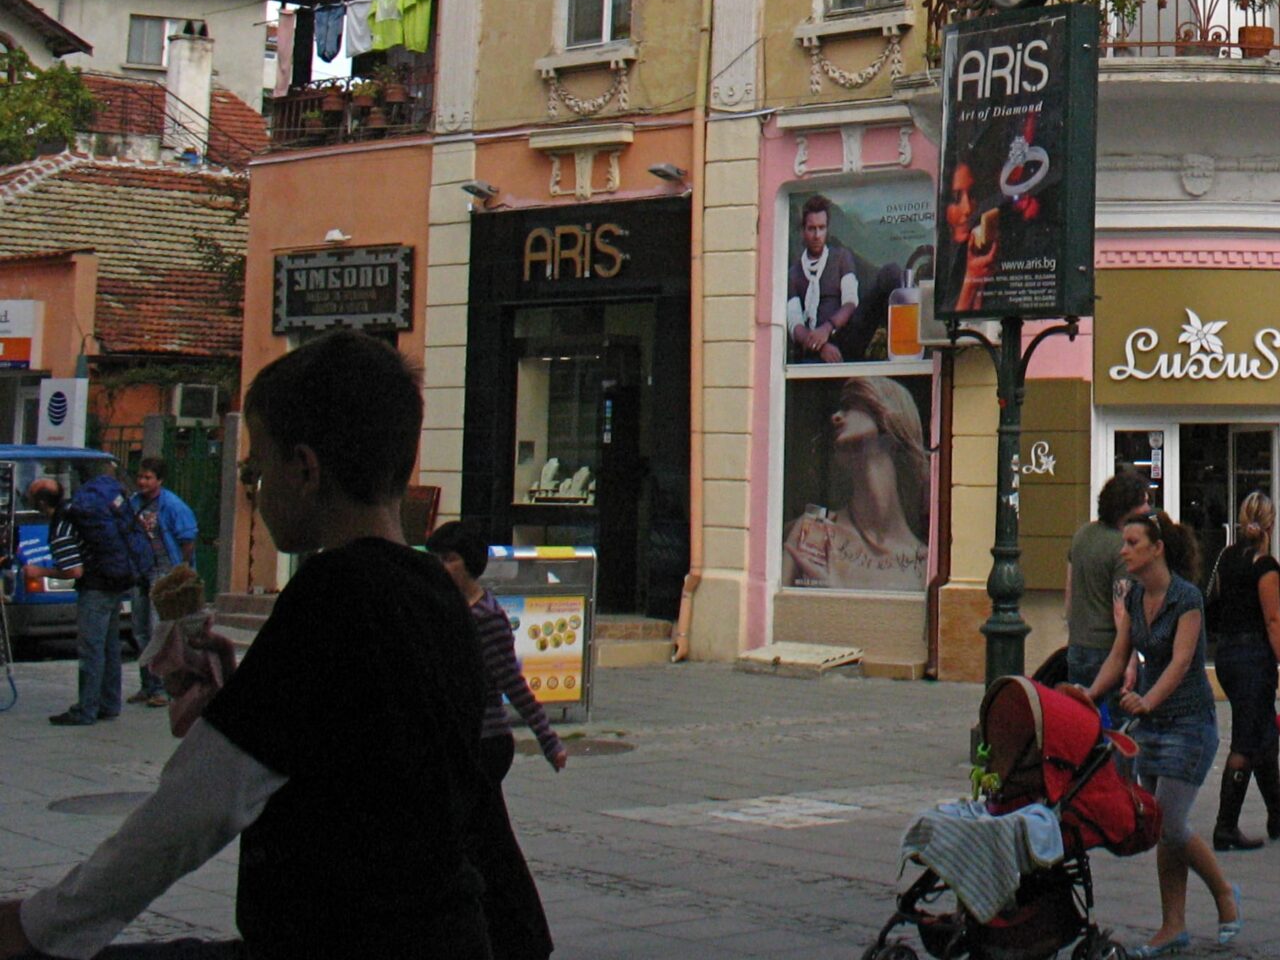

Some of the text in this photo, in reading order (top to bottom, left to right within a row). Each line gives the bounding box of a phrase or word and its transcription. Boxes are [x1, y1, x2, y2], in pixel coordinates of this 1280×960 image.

[958, 100, 1043, 122] Art of Diamond
[1001, 257, 1056, 271] www.aris.bg
